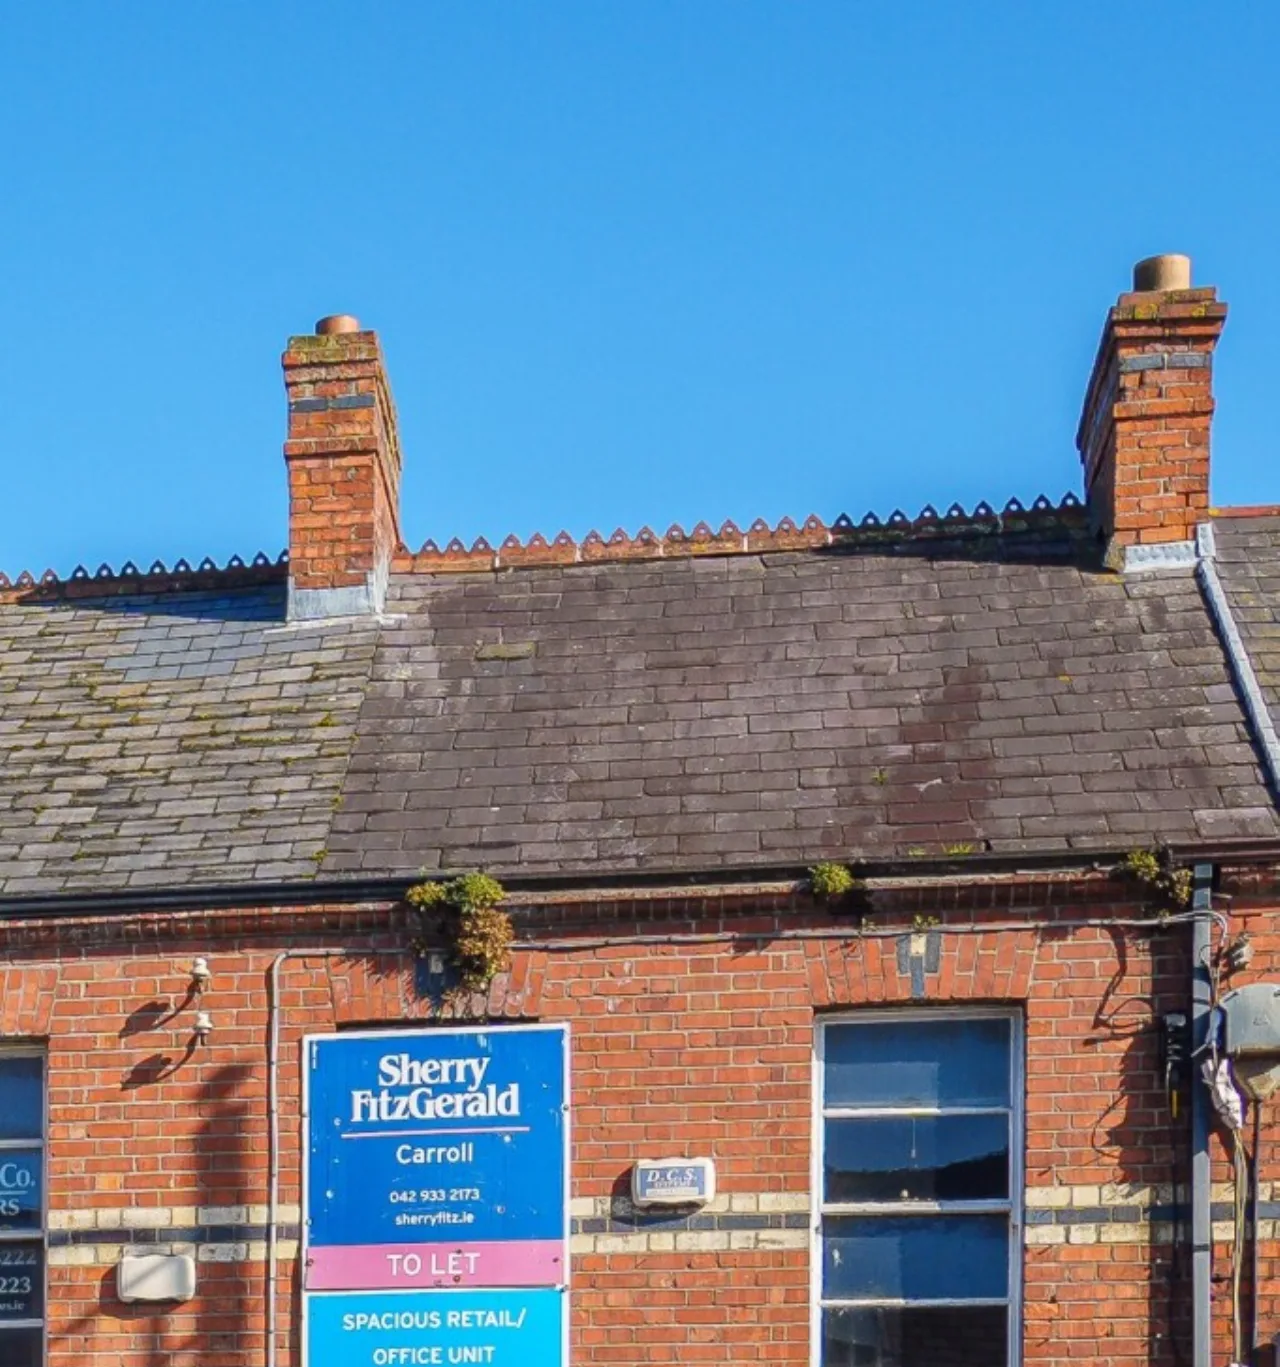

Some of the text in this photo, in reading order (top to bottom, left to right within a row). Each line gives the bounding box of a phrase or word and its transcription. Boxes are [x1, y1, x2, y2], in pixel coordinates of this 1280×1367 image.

[378, 1053, 491, 1091] Sherry
[351, 1082, 520, 1122] FitzGerald
[395, 1142, 473, 1164] Carroll
[0, 1163, 36, 1188] Co.
[390, 1188, 480, 1203] 042 933 2173
[395, 1211, 475, 1227] sherryfitz.ie
[386, 1253, 480, 1276] TO LET
[343, 1308, 527, 1330] SPACIOUS RETAIL/
[373, 1346, 495, 1365] OFFICE UNIT
